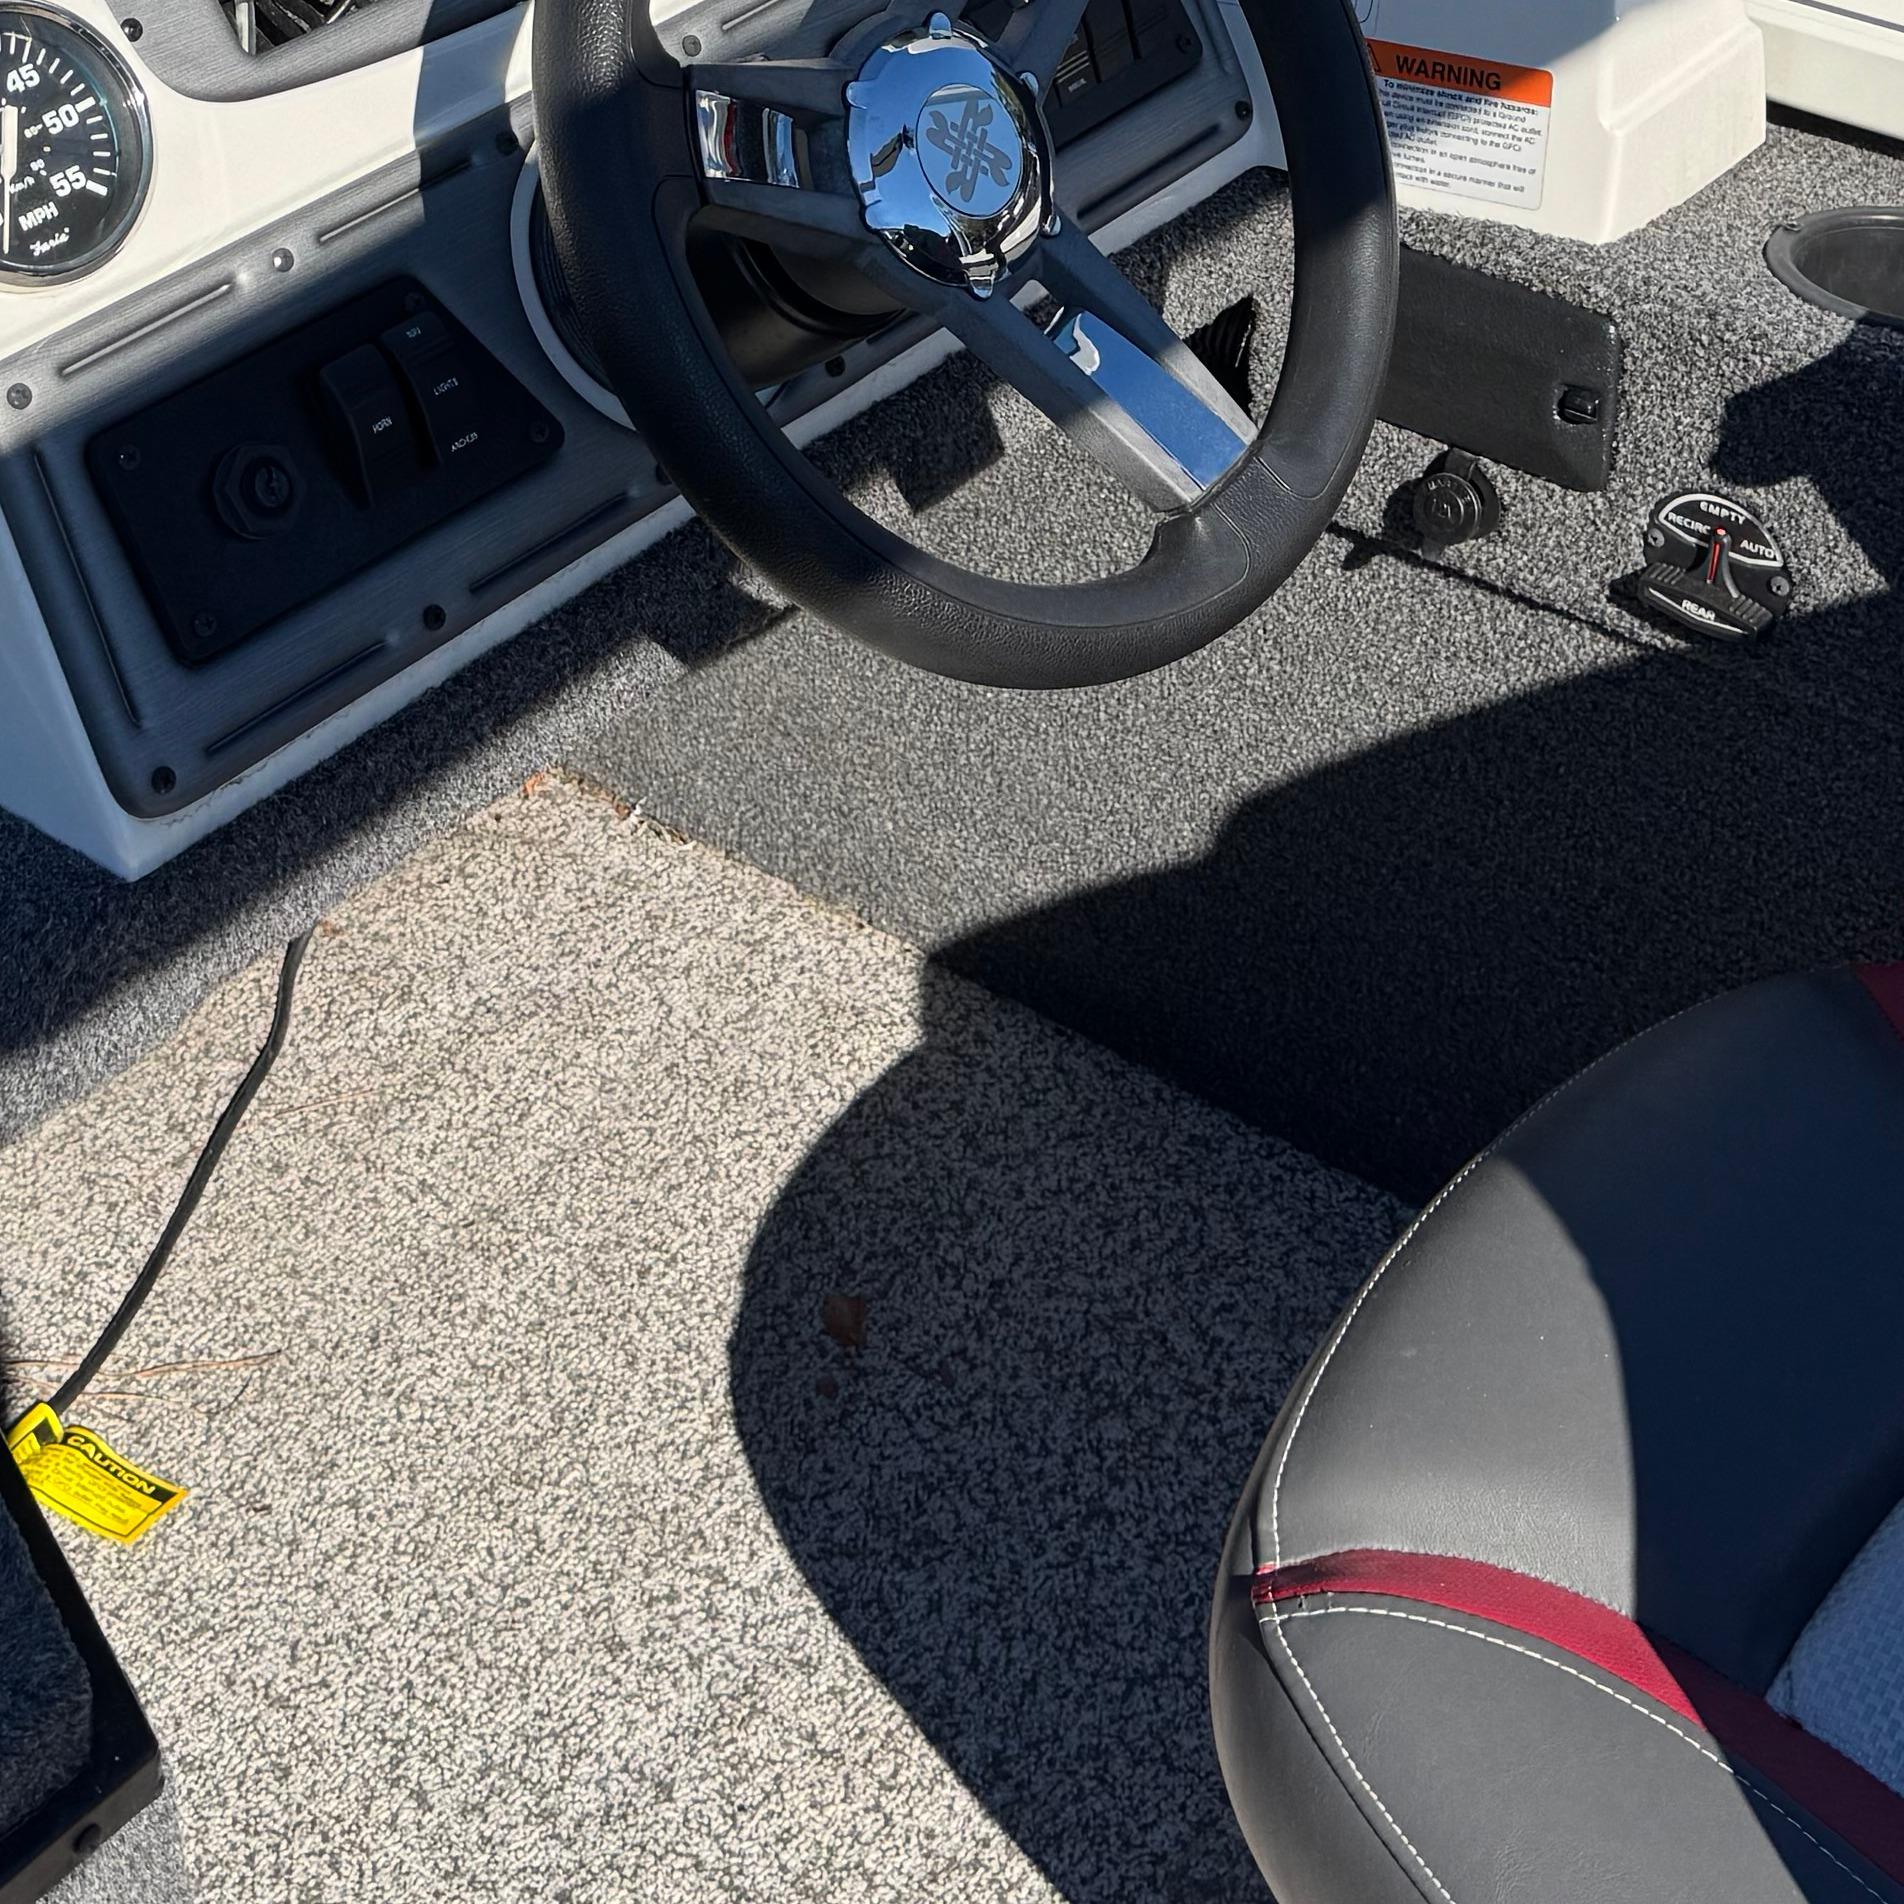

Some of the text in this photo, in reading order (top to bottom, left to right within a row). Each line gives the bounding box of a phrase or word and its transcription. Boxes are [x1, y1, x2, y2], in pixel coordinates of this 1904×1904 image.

[6, 63, 40, 93] 45
[1396, 54, 1502, 91] WARNING
[42, 103, 80, 135] 50
[49, 165, 87, 198] 55
[18, 201, 59, 231] MPH
[1667, 511, 1711, 535] RECIRC
[1699, 500, 1746, 526] EMPTY
[1739, 538, 1775, 559] AUTO
[1680, 598, 1716, 622] REAR
[66, 1434, 156, 1495] CAUTION
